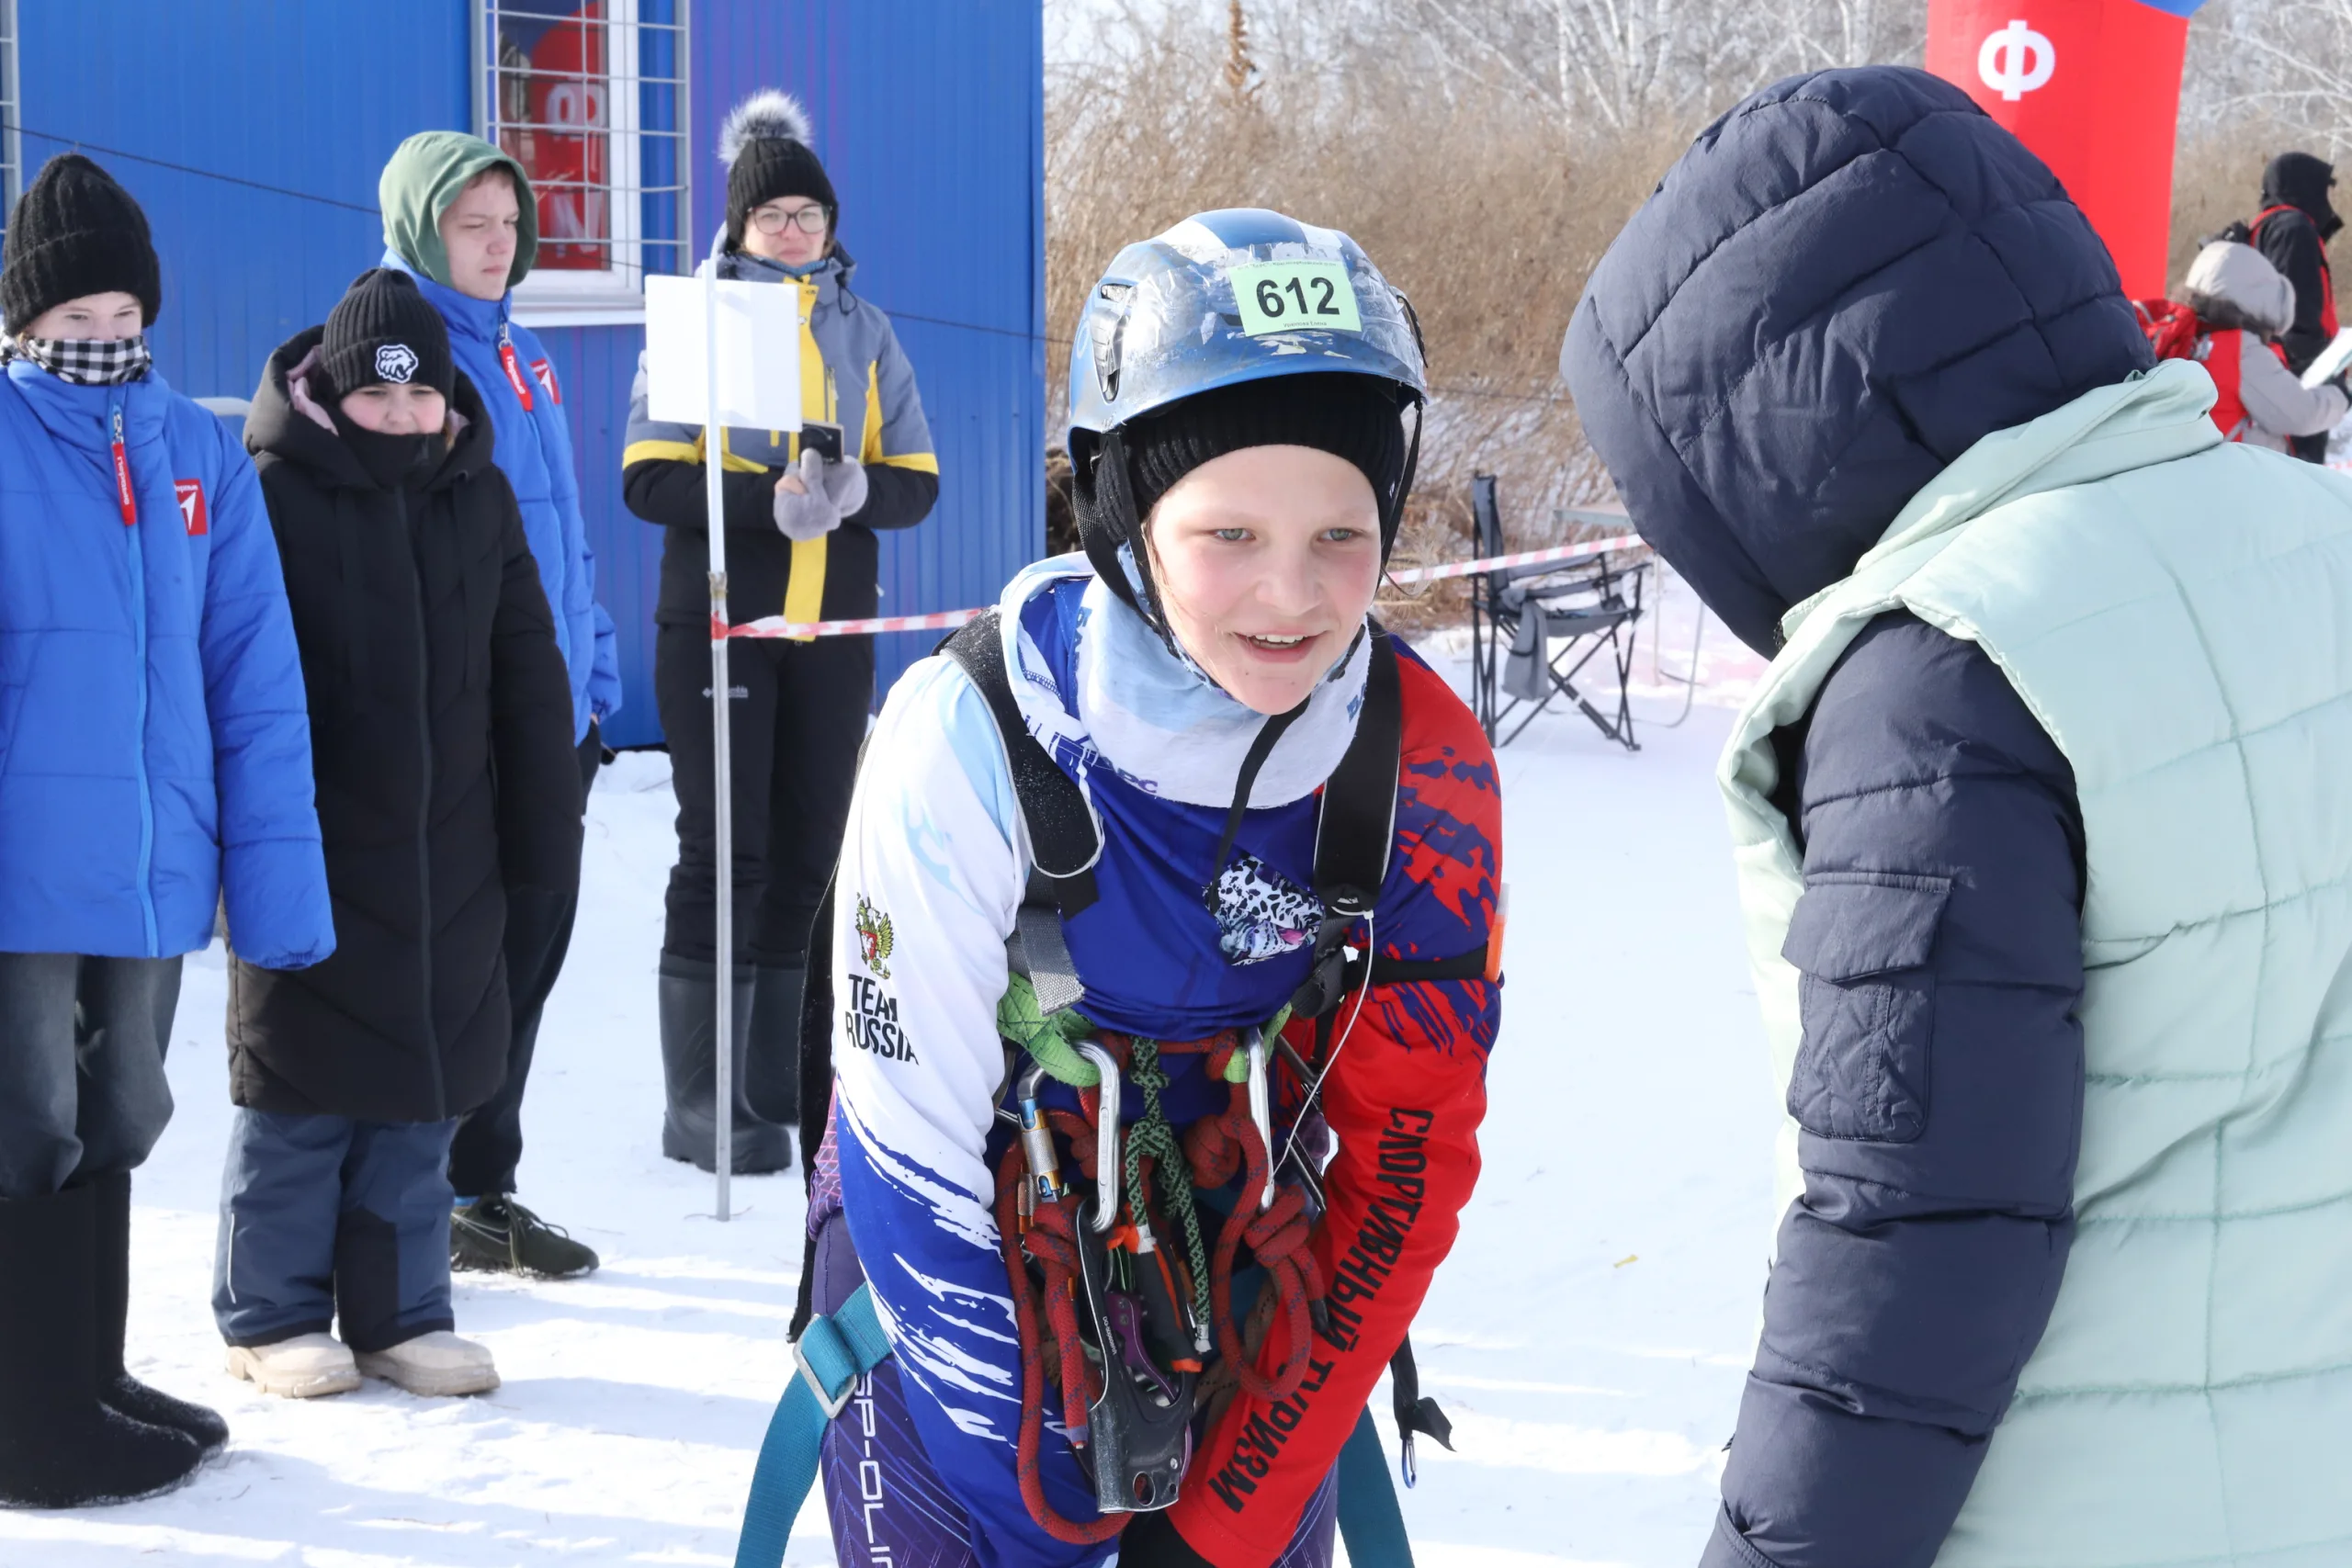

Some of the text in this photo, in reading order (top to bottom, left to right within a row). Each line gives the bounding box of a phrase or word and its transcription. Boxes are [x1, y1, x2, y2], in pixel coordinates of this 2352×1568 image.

[1977, 19, 2055, 101] Ф
[1256, 276, 1340, 318] 612
[1312, 1107, 1434, 1353] СПОРТИВНЫЙ
